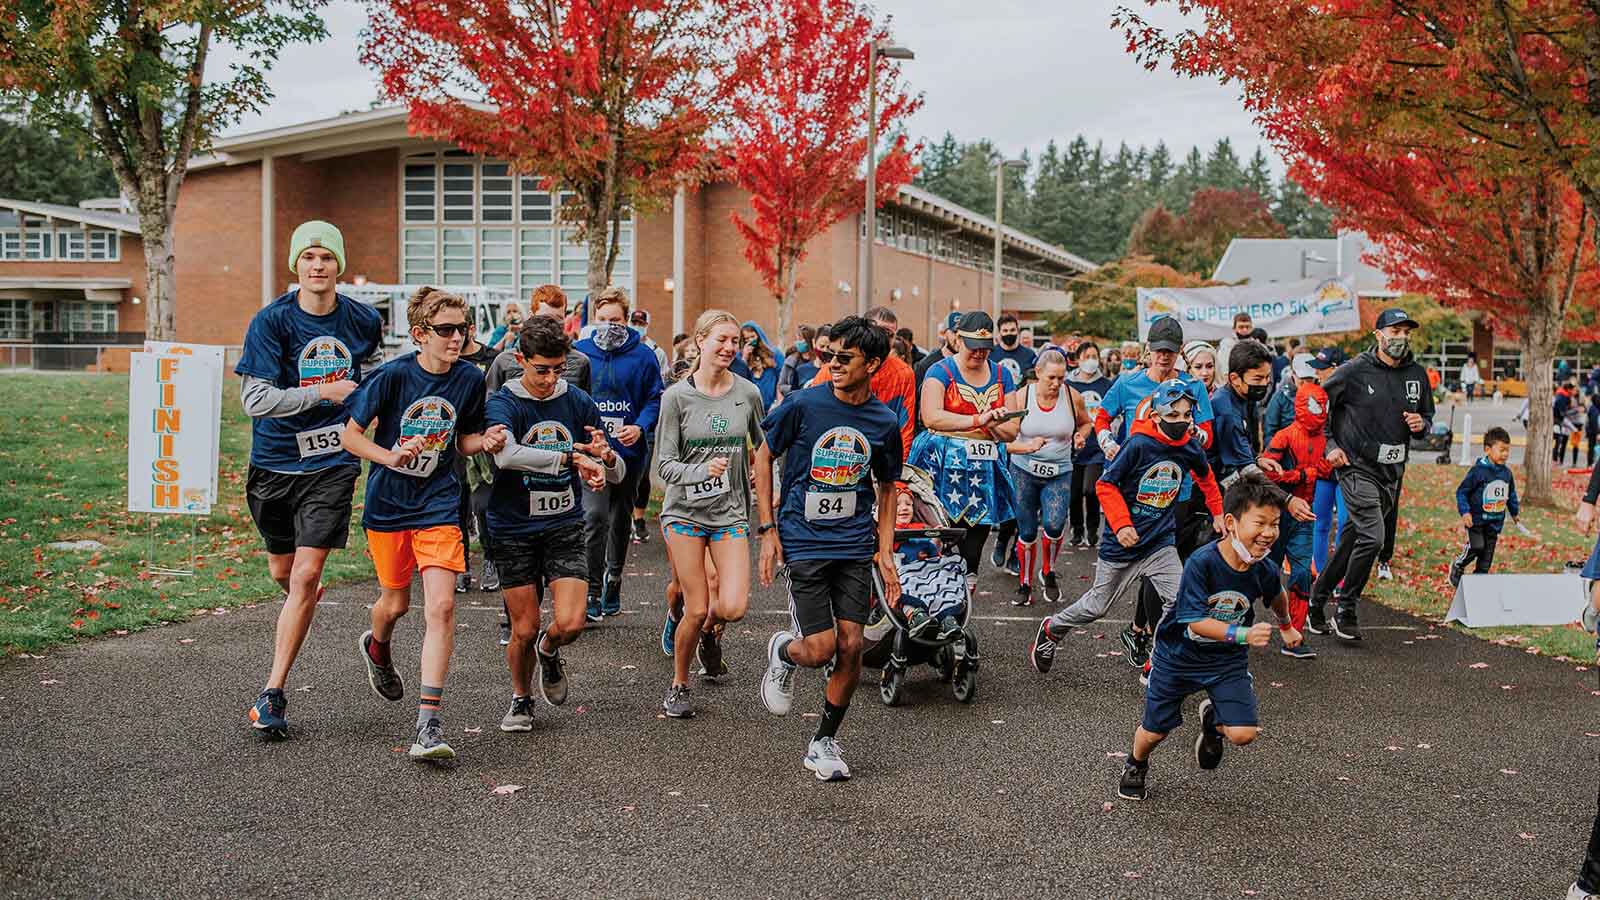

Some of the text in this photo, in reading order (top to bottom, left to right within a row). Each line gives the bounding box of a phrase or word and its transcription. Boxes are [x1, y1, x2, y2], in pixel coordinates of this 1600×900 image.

[1289, 300, 1308, 316] 5K
[302, 358, 351, 368] SUPERHERO
[152, 357, 181, 509] FINISH
[305, 431, 341, 451] 153
[815, 448, 868, 461] SUPERHERO
[970, 444, 993, 456] 167
[1386, 448, 1400, 460] 53
[401, 455, 433, 472] 07
[1031, 463, 1055, 476] 165
[693, 477, 723, 494] 164
[1494, 487, 1505, 497] 61
[538, 495, 571, 511] 105
[818, 498, 843, 514] 84
